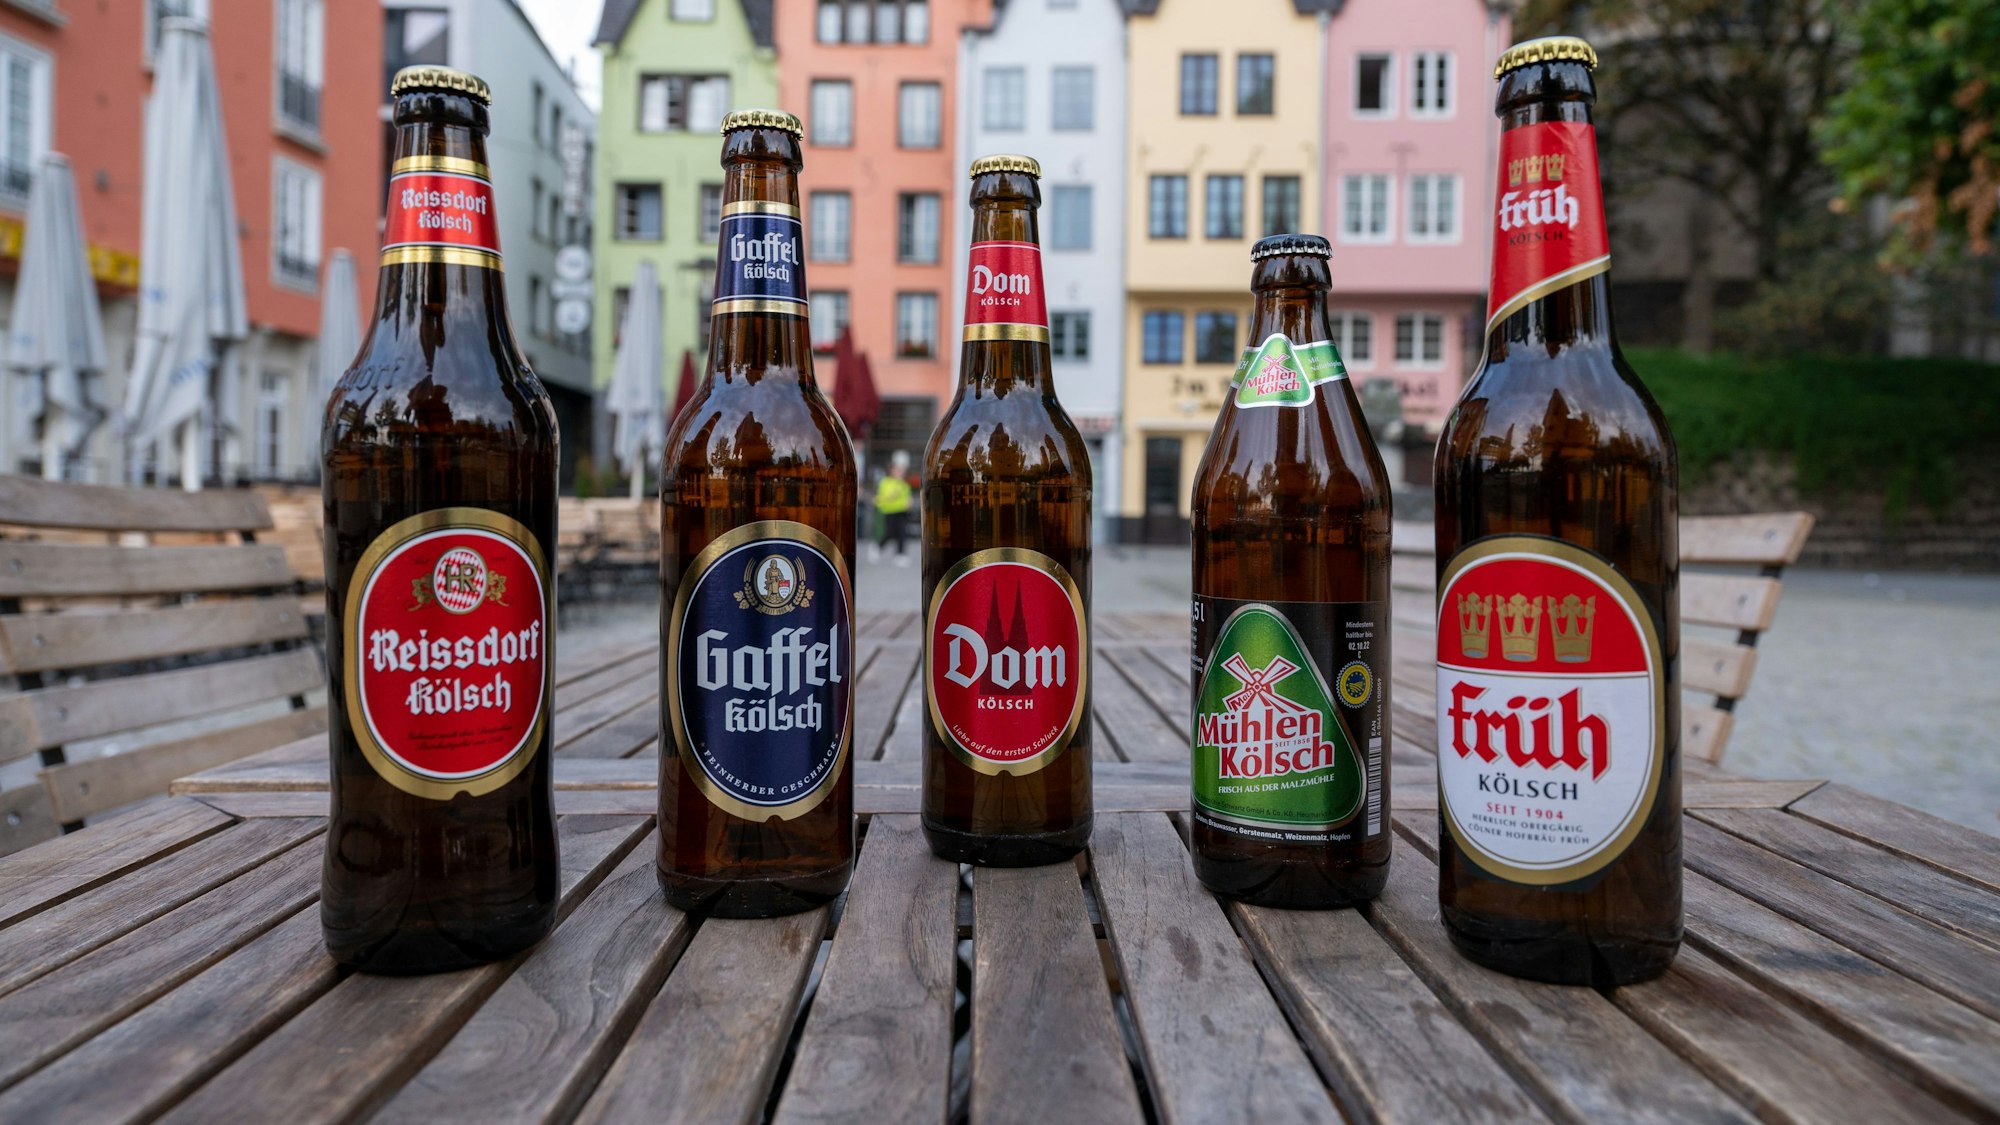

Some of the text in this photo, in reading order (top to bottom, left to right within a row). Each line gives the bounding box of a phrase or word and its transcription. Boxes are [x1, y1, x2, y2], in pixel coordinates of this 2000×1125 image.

[401, 187, 486, 215] Reissdorf
[417, 209, 473, 234] Kölsch
[731, 232, 799, 266] Gaffel
[744, 263, 789, 283] Kölsch
[972, 264, 1030, 295] Dom
[981, 296, 1020, 306] KÖLSCH
[1246, 370, 1297, 389] Mühlen
[1256, 380, 1300, 396] Kölsch
[368, 619, 540, 672] Reissdorf
[943, 623, 1066, 689] Dom
[697, 623, 842, 696] Gaffel
[405, 671, 511, 715] Kölsch
[977, 697, 1034, 710] KÖLSCH
[1231, 690, 1252, 712] Malz
[725, 693, 822, 733] Kölsch
[1199, 708, 1321, 745] Mühlen
[953, 724, 1058, 757] Liebe auf den ersten Schluck
[1275, 739, 1291, 748] SEIT
[704, 741, 837, 795] FEINHERBER GESCHMACK
[1220, 736, 1333, 778] Kölsch
[1218, 786, 1242, 794] FRISCH
[1262, 783, 1279, 792] DER
[1280, 773, 1335, 790] MALZMÜHLE
[1478, 773, 1578, 800] KÖLSCH
[1472, 813, 1583, 833] HERRLICH OBERGÄRIG
[1486, 802, 1564, 820] SEIT 1904
[1208, 819, 1238, 834] Brauwasser,
[1239, 827, 1284, 841] Gerstenmalz,
[1285, 832, 1329, 842] Weizenmalz,
[1468, 823, 1589, 844] CÖLNER HOFBRÄU FRÜH
